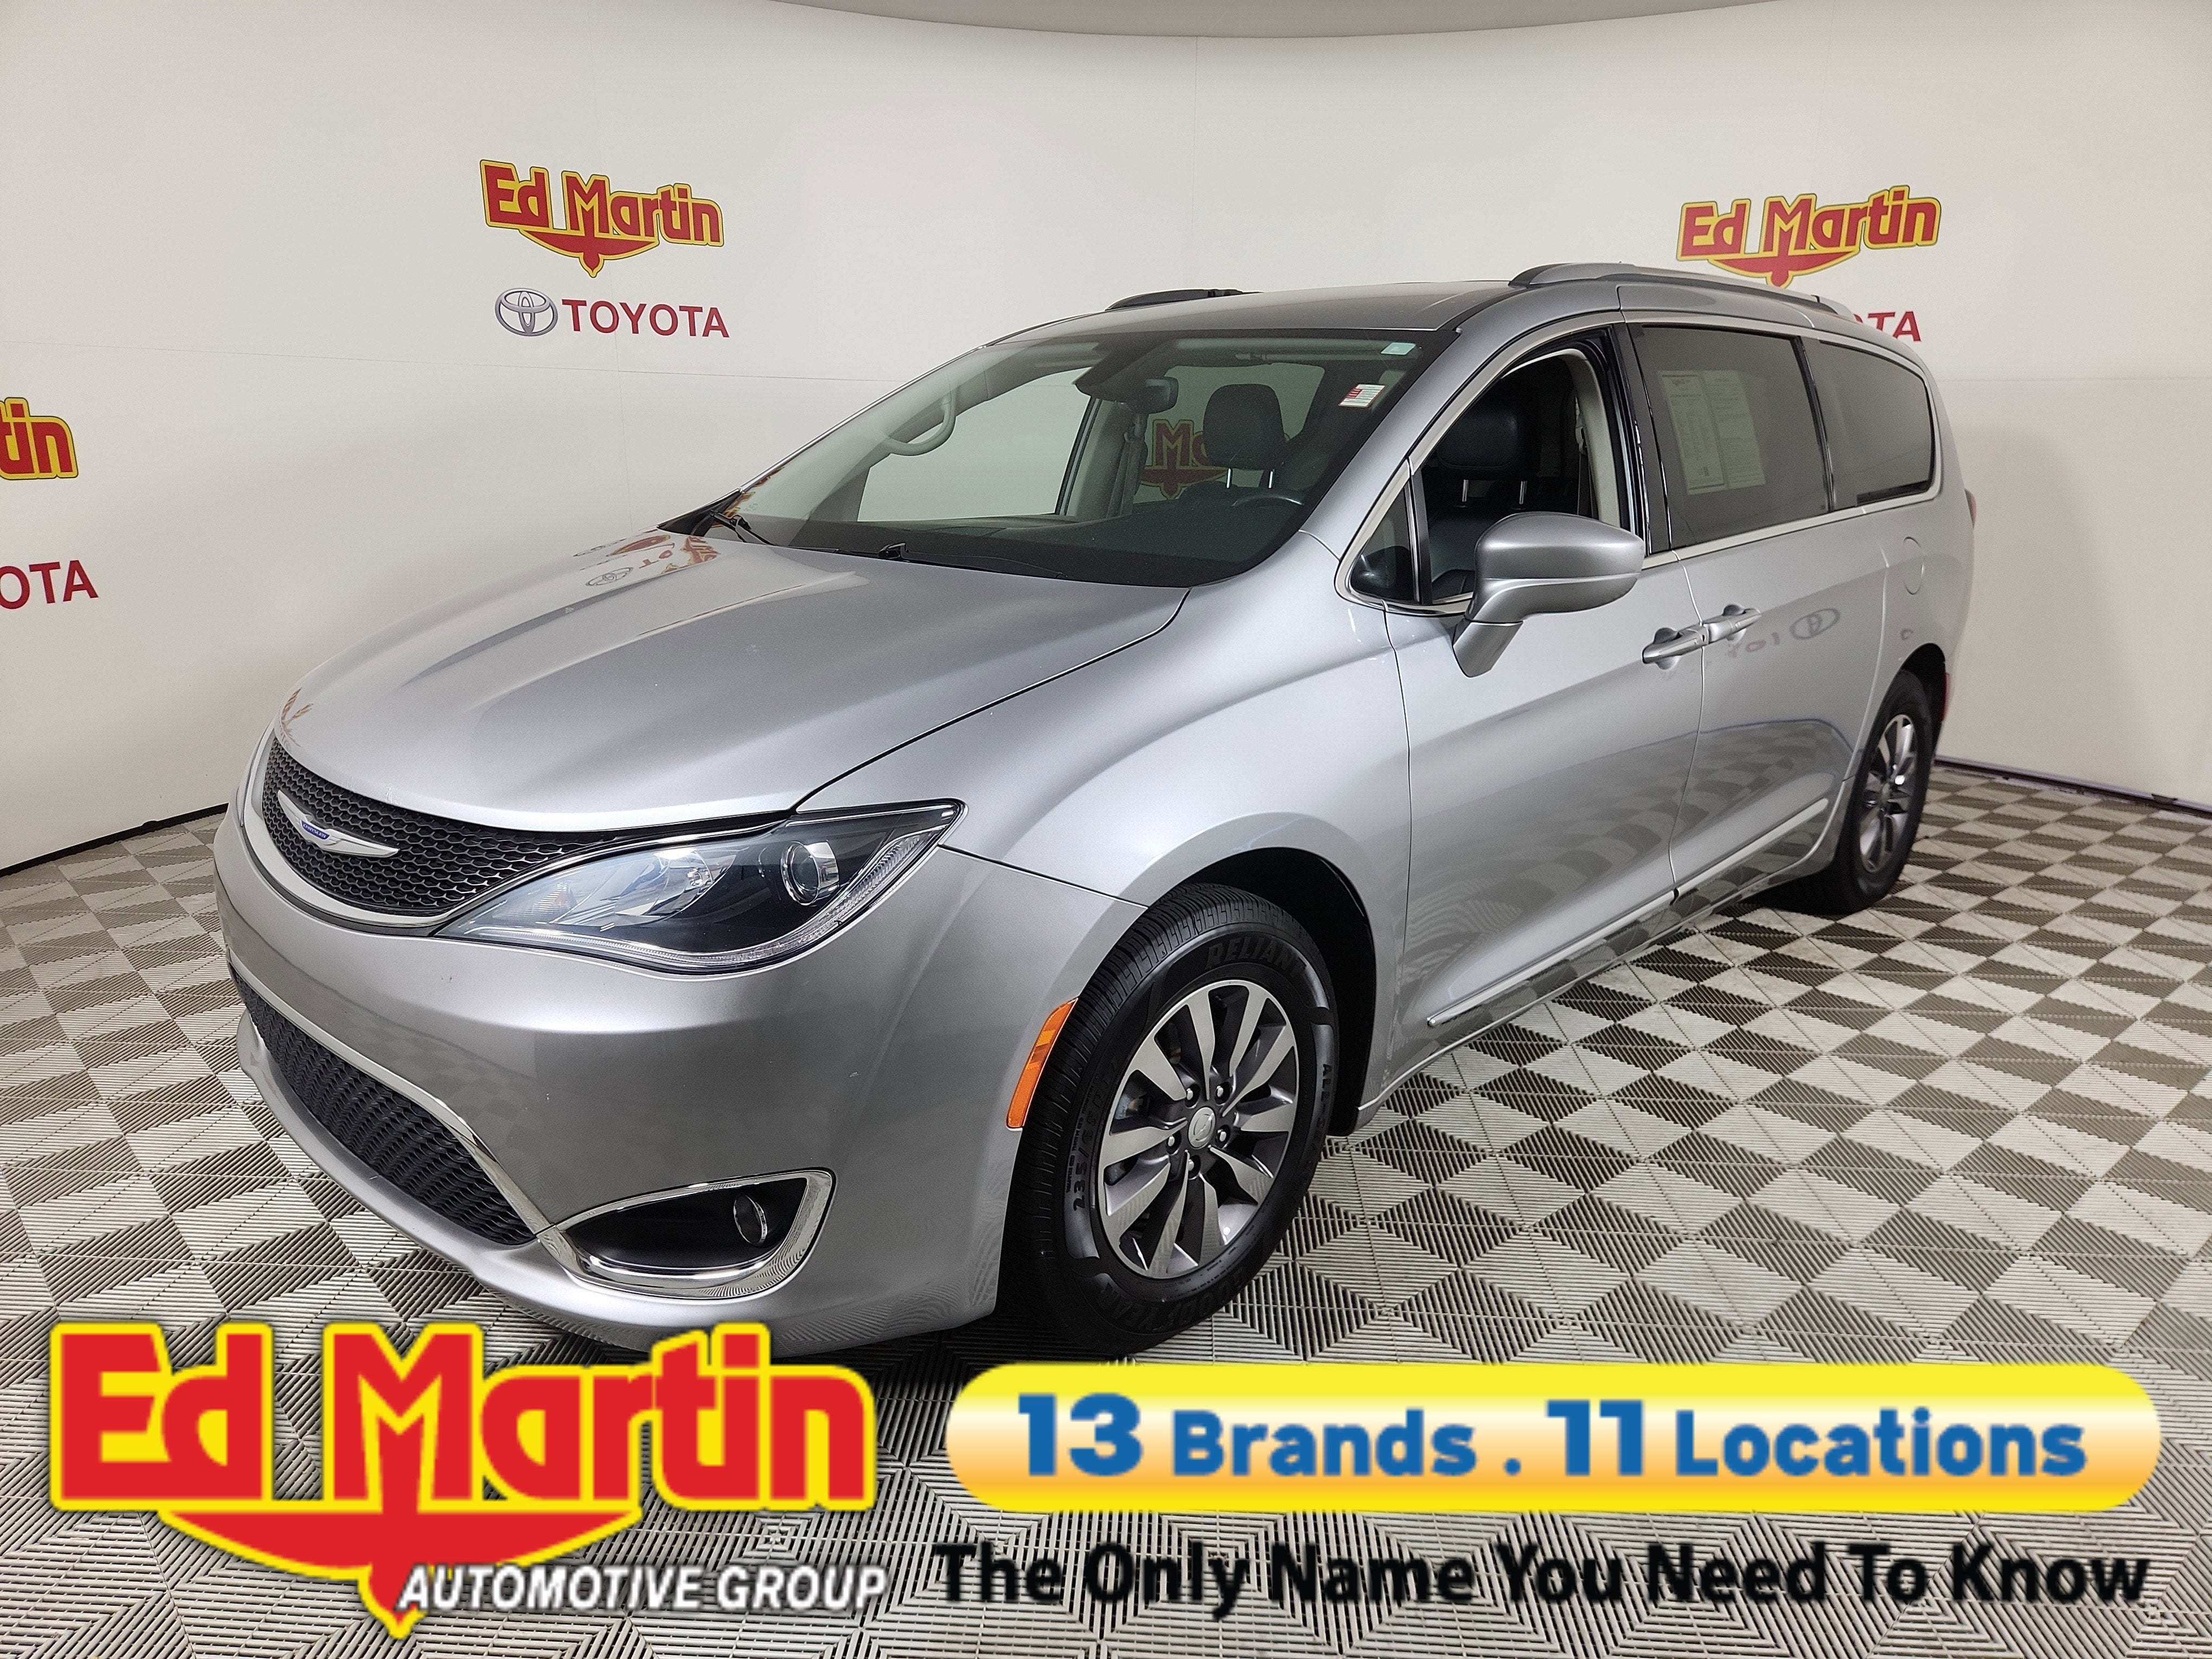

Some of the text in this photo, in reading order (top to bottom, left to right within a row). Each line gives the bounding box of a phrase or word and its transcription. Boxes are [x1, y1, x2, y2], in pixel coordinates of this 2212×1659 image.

[481, 162, 723, 246] Ed Martin
[1678, 186, 1940, 260] Ed Martin
[562, 299, 730, 338] TOYOTA
